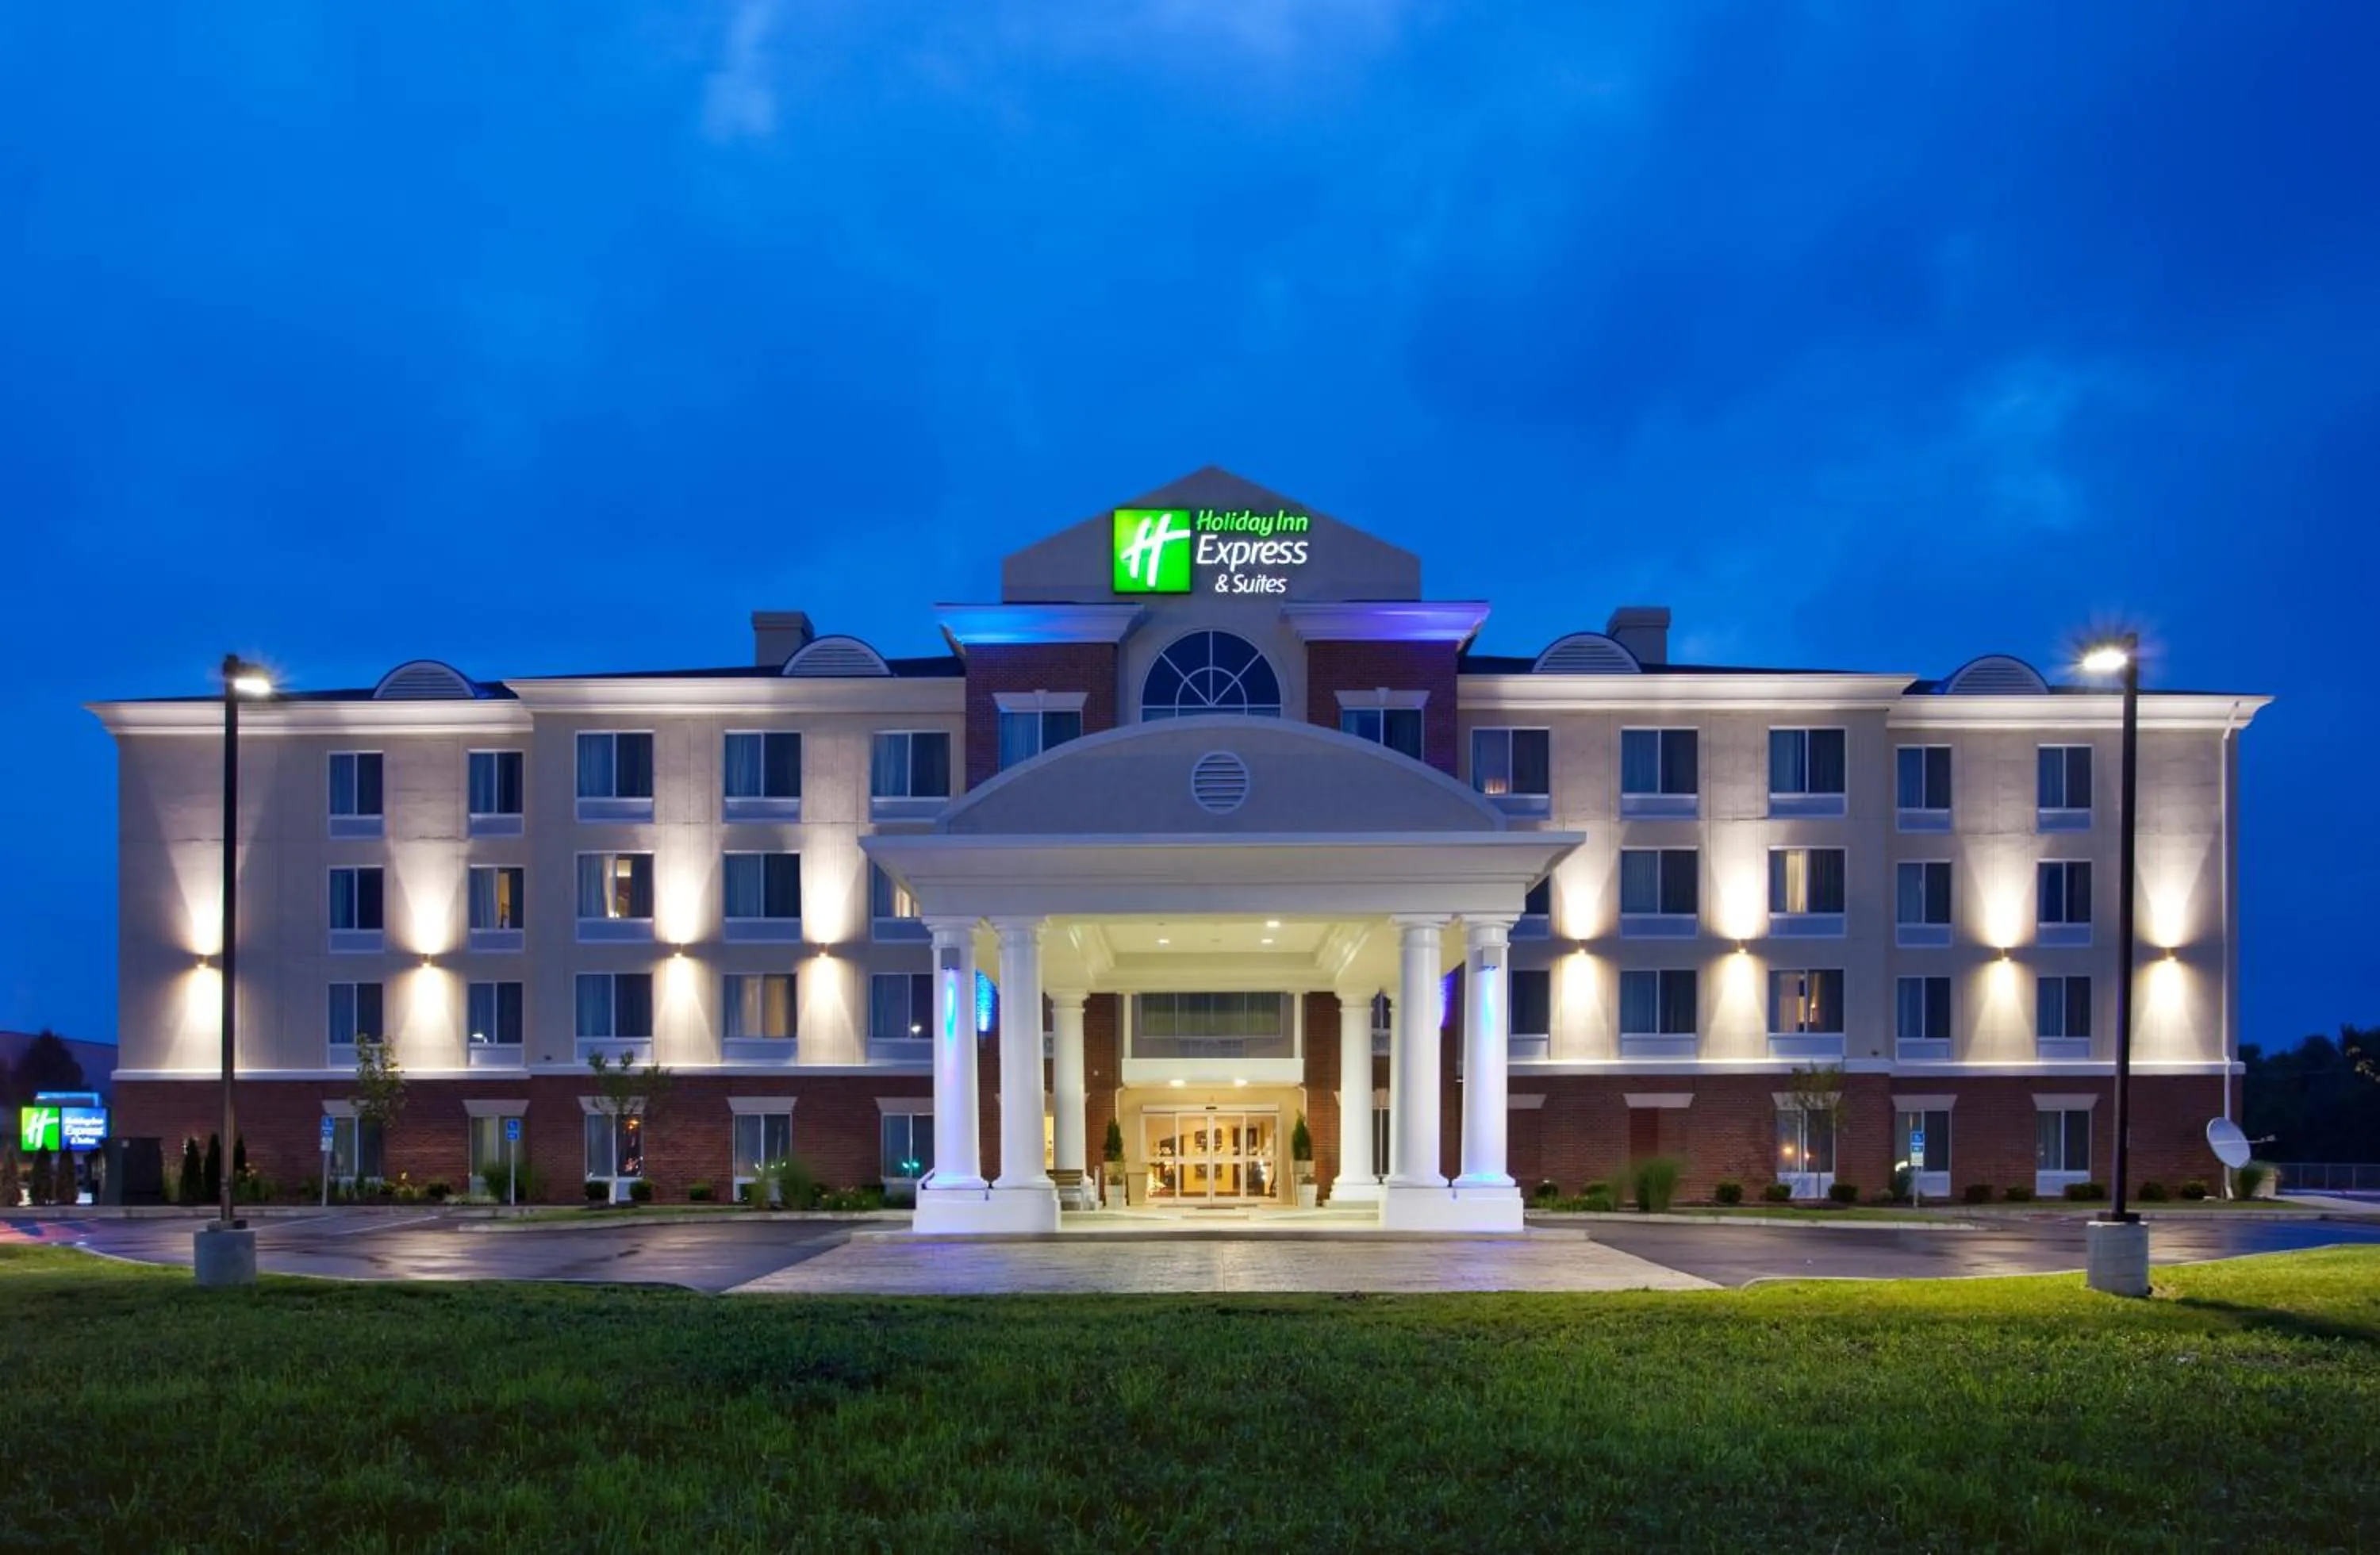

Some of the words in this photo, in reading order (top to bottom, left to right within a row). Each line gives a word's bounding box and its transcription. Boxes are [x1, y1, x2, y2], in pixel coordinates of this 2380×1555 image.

[1196, 510, 1273, 536] Holiday
[1276, 510, 1308, 532] Inn
[1196, 534, 1308, 572] Express
[1215, 574, 1228, 593] &
[1232, 574, 1287, 593] Suites
